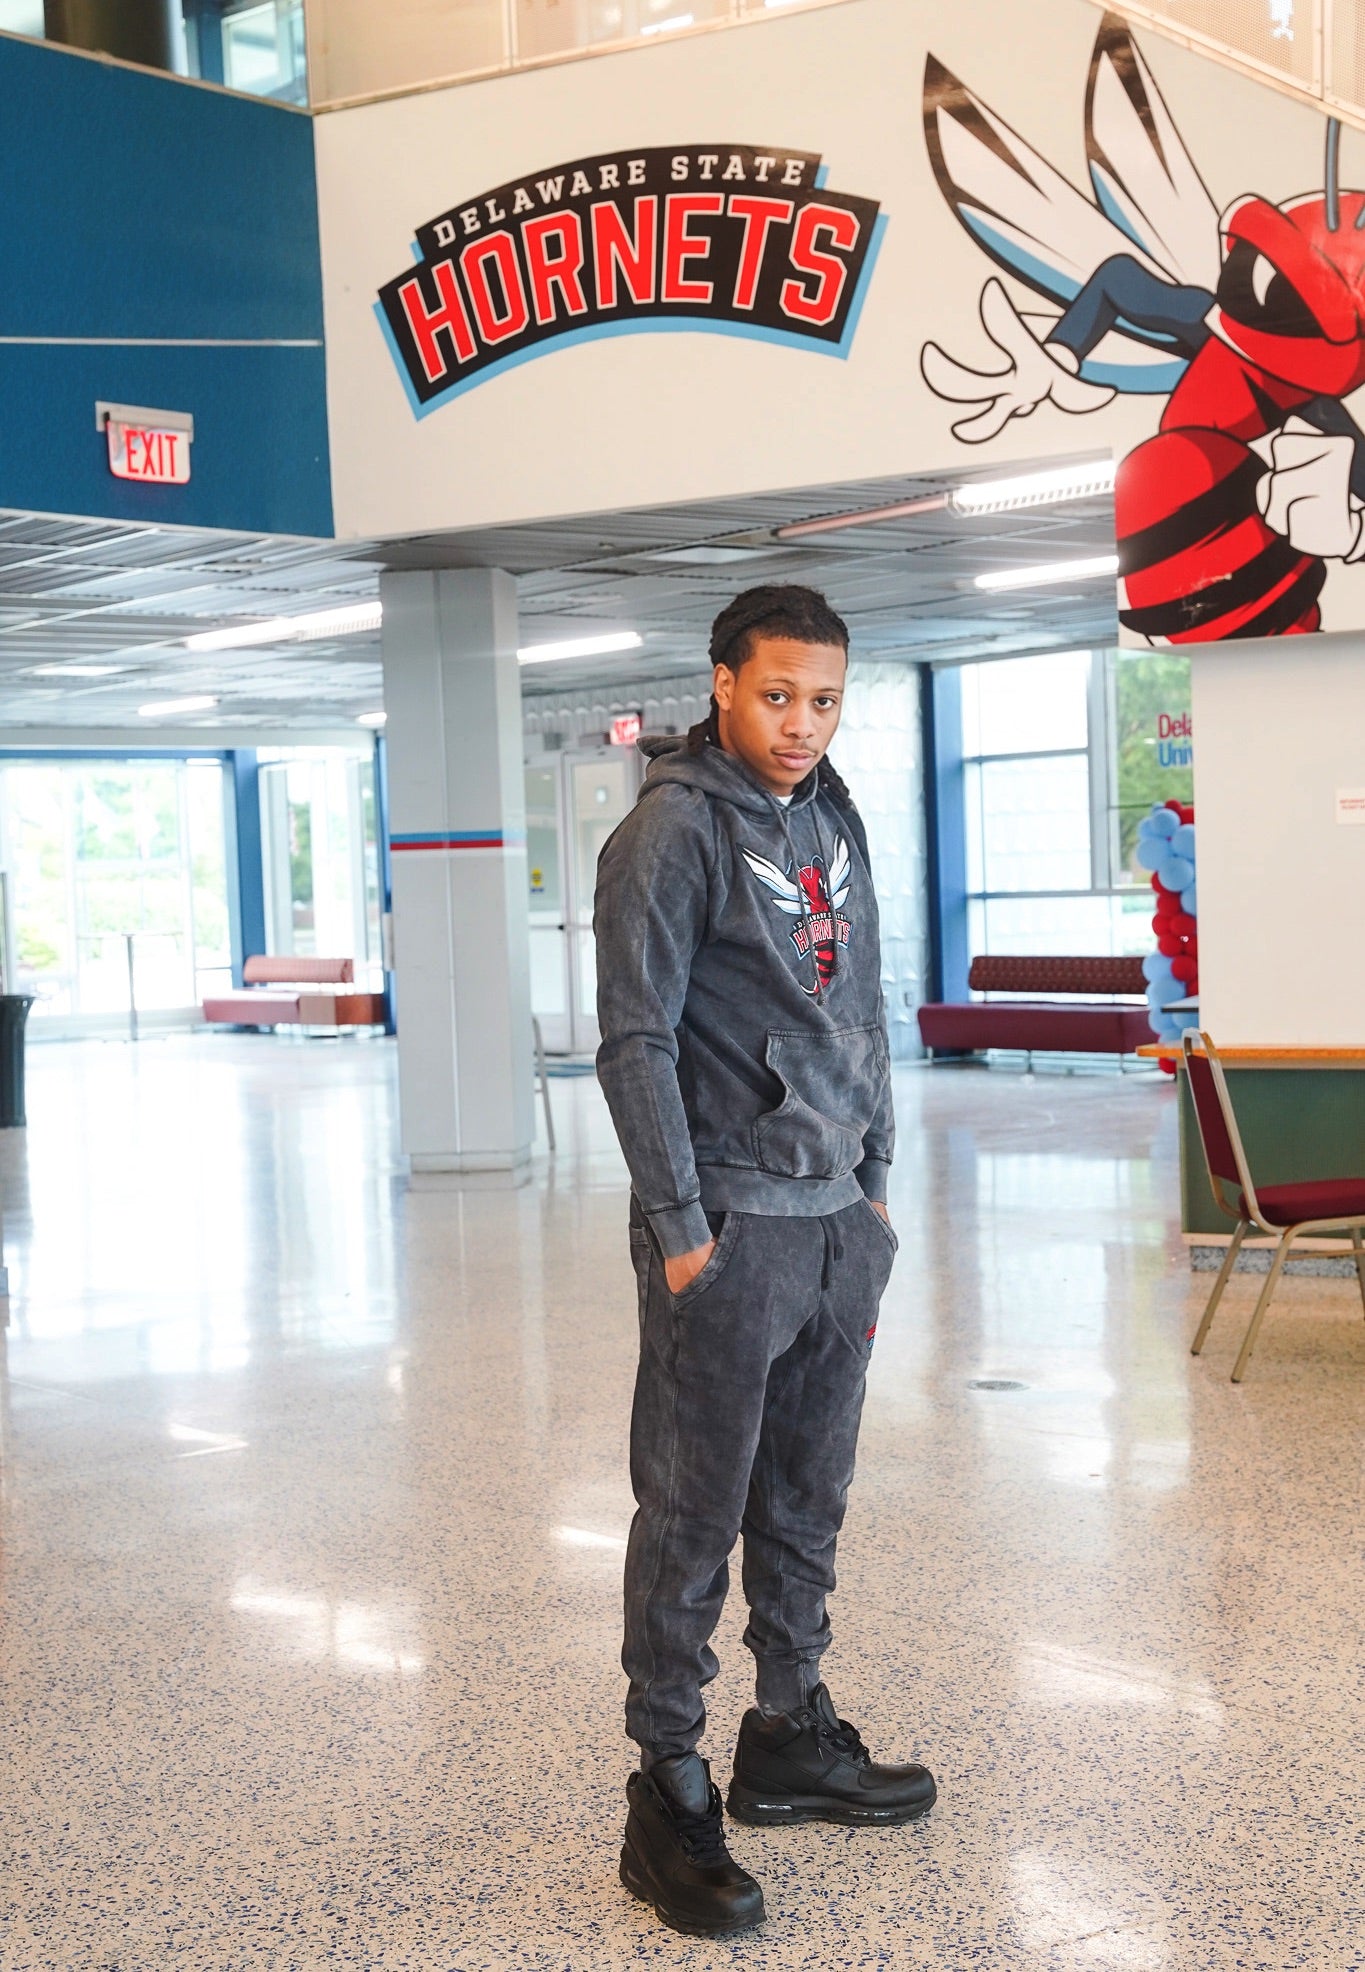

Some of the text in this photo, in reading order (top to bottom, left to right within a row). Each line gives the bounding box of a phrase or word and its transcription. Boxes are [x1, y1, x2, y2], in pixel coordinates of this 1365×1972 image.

[433, 155, 806, 248] DELAWARE STATE
[397, 192, 861, 384] HORNETS
[126, 430, 177, 477] EXIT
[793, 919, 850, 954] HRNETS
